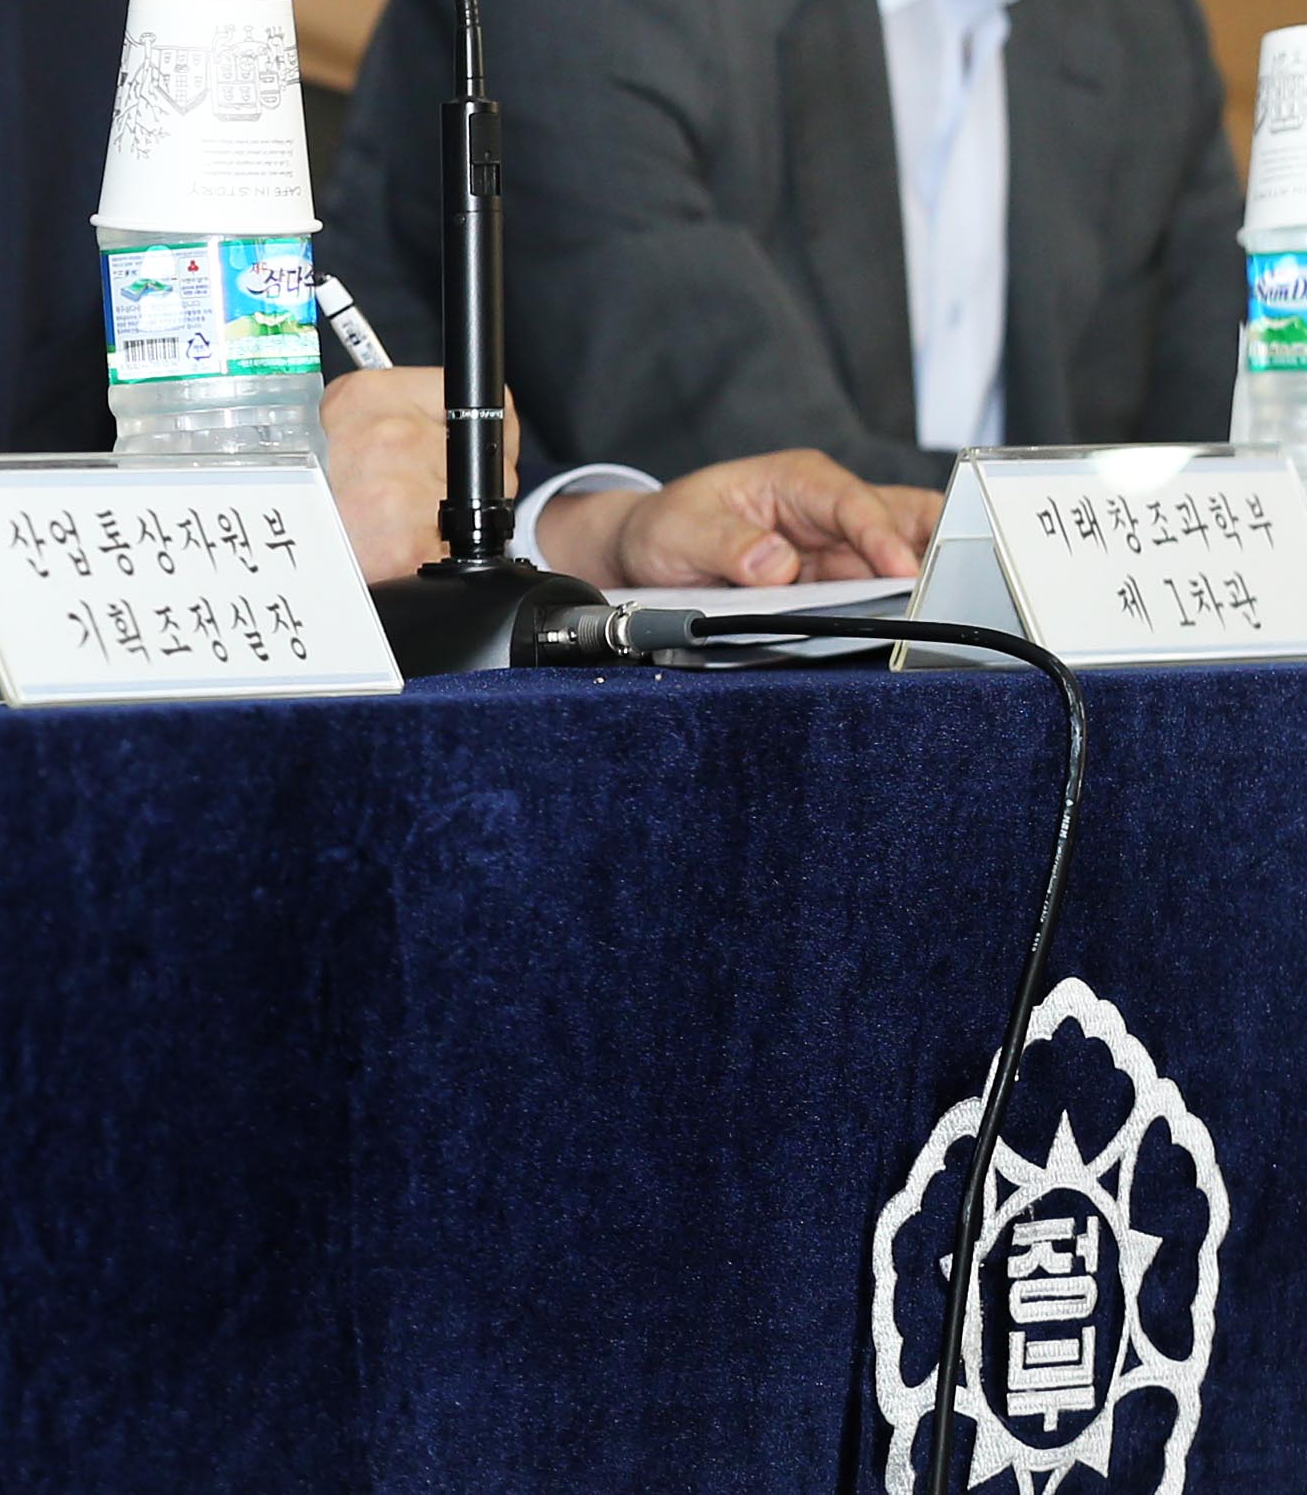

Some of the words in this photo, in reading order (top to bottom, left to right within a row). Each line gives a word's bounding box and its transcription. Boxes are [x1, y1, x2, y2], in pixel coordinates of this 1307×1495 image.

[10, 507, 299, 578] 산업통상자원부
[1036, 492, 1275, 557] 미래창조과학부
[66, 593, 308, 666] 기획조정실장
[1117, 572, 1154, 634] 제
[1164, 570, 1262, 630] 1차관
[1006, 1214, 1100, 1432] 정부
